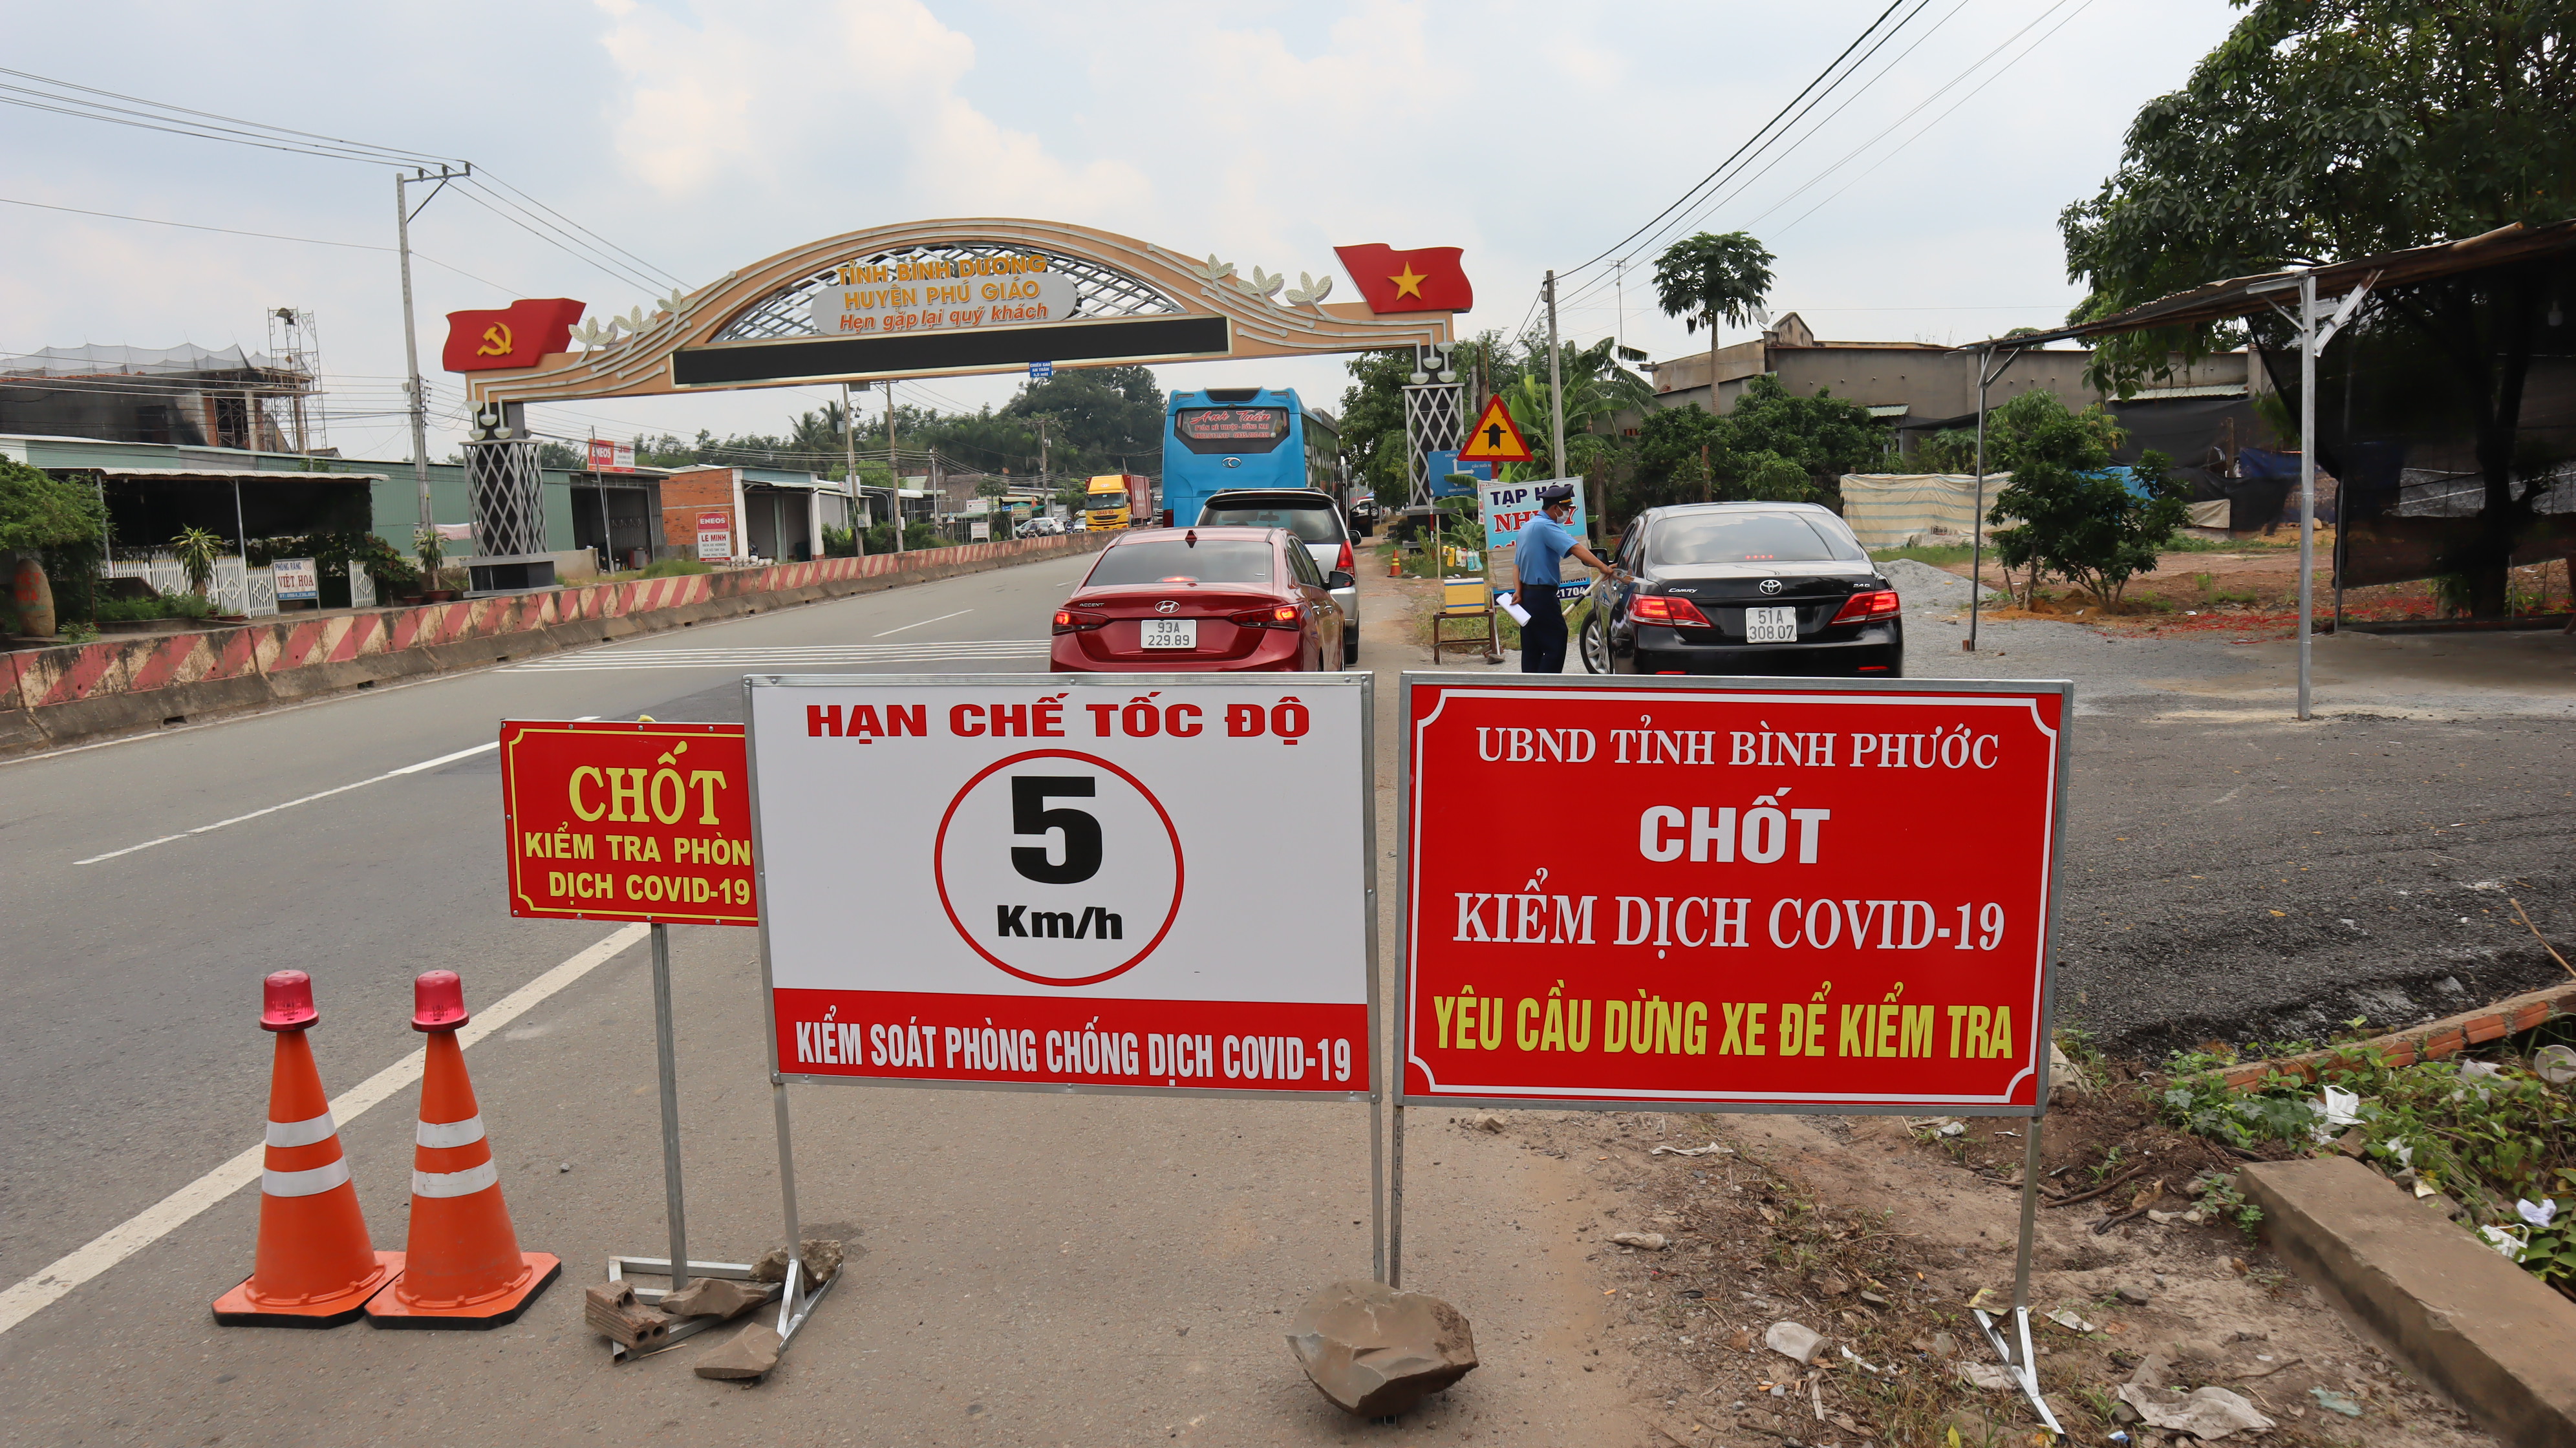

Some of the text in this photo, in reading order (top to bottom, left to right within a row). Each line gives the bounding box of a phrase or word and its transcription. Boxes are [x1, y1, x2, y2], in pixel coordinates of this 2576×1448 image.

[837, 254, 1047, 285] TỈNH BÌNH DƯƠNG
[844, 276, 1040, 312] HUYỆN PHÚ GIÁO
[840, 302, 1048, 333] Hẹn gặp lại quý khách
[1190, 410, 1271, 424] Anh Tuấn
[1490, 489, 1527, 507] TẠP
[277, 573, 314, 590] VIỆT HOA
[1157, 622, 1180, 633] 93A
[1749, 625, 1794, 640] 308.07
[1758, 610, 1784, 624] 51A
[1148, 635, 1190, 646] 229.89
[807, 693, 1309, 744] HẠN CHẾ TỐC ĐỘ
[1476, 715, 1997, 769] UBND TỈNH BÌNH PHƯỚC
[565, 741, 726, 826] CHỐT
[1011, 776, 1102, 884] 5
[1640, 788, 1830, 863] CHỐT
[526, 820, 750, 865] KIỂM TRA PHÒN
[550, 872, 749, 904] DỊCH COVID-19
[998, 906, 1122, 939] Km/h
[1454, 868, 2004, 959] KIỂM DỊCH COVID-19
[1434, 980, 2012, 1058] YÊU CẦU DỪNG XE ĐỂ KIỂM TRA
[797, 1005, 1350, 1085] KIỂM SOÁT PHÒNG CHỐNG DỊCH COVID-19
